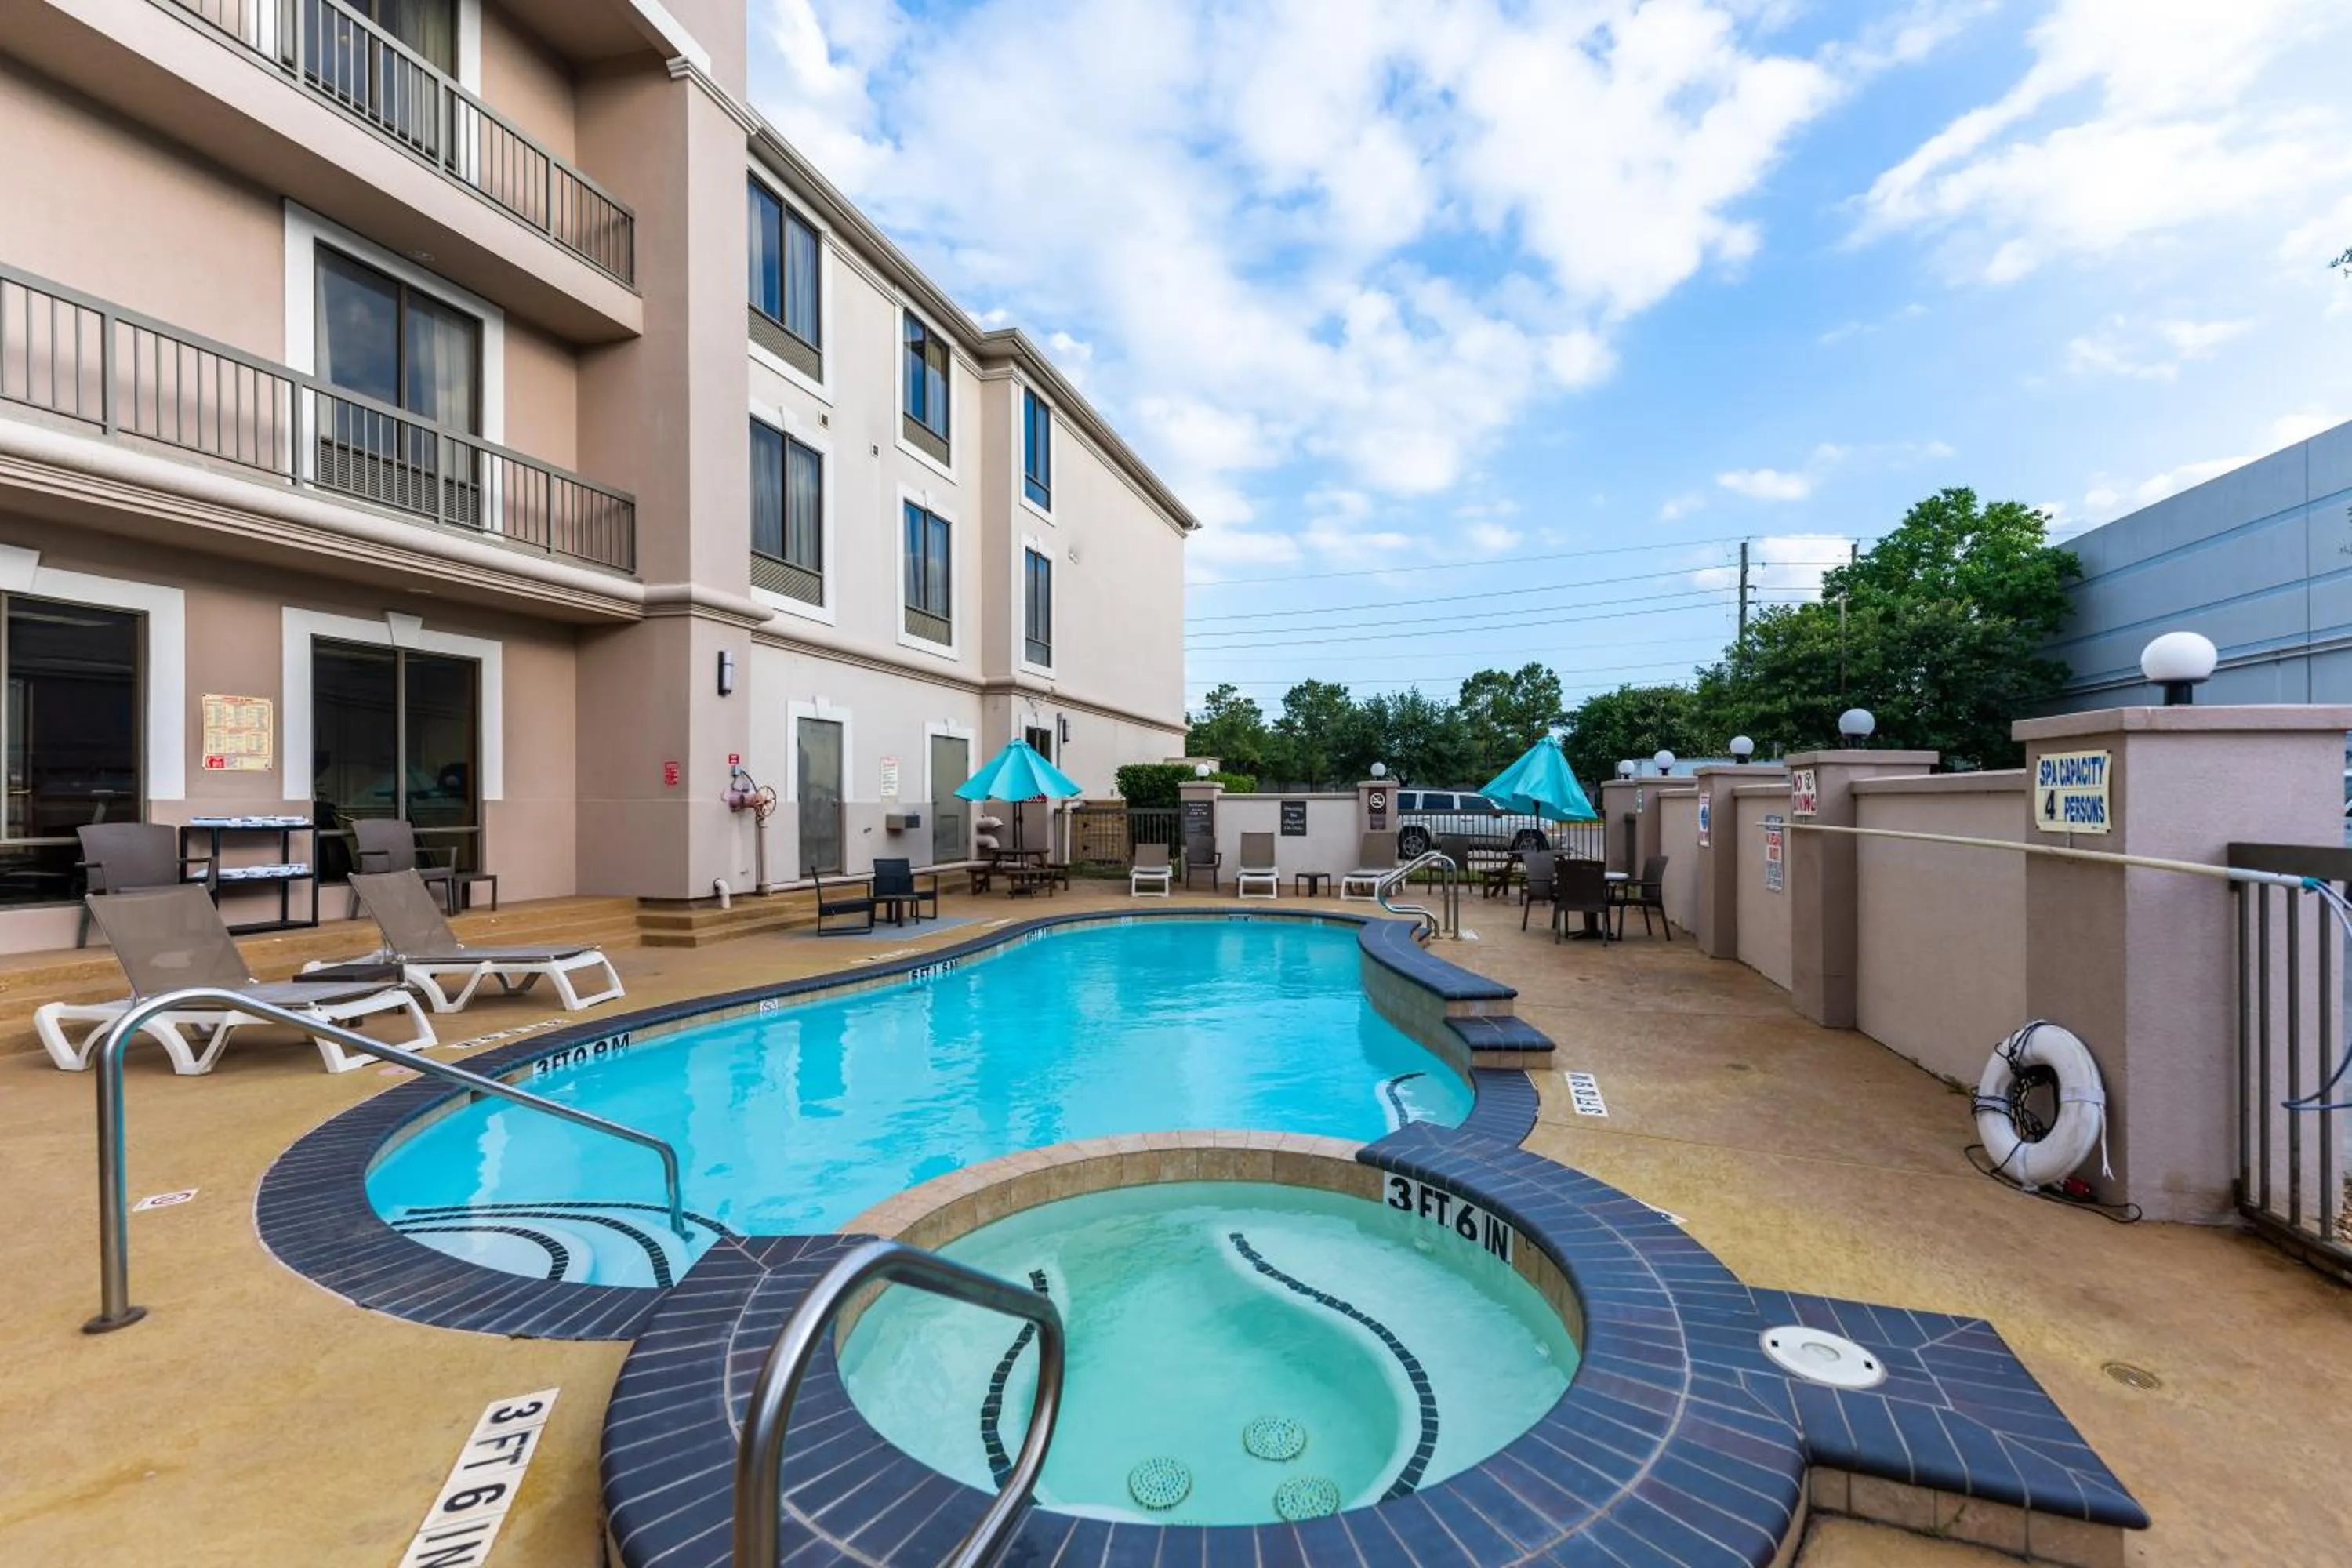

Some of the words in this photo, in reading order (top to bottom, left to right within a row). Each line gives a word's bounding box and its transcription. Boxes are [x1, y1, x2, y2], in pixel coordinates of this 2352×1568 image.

[2040, 759, 2057, 786] SPA
[2060, 756, 2106, 786] CAPACITY
[2045, 789, 2055, 820] 4
[2064, 795, 2104, 823] PERSONS
